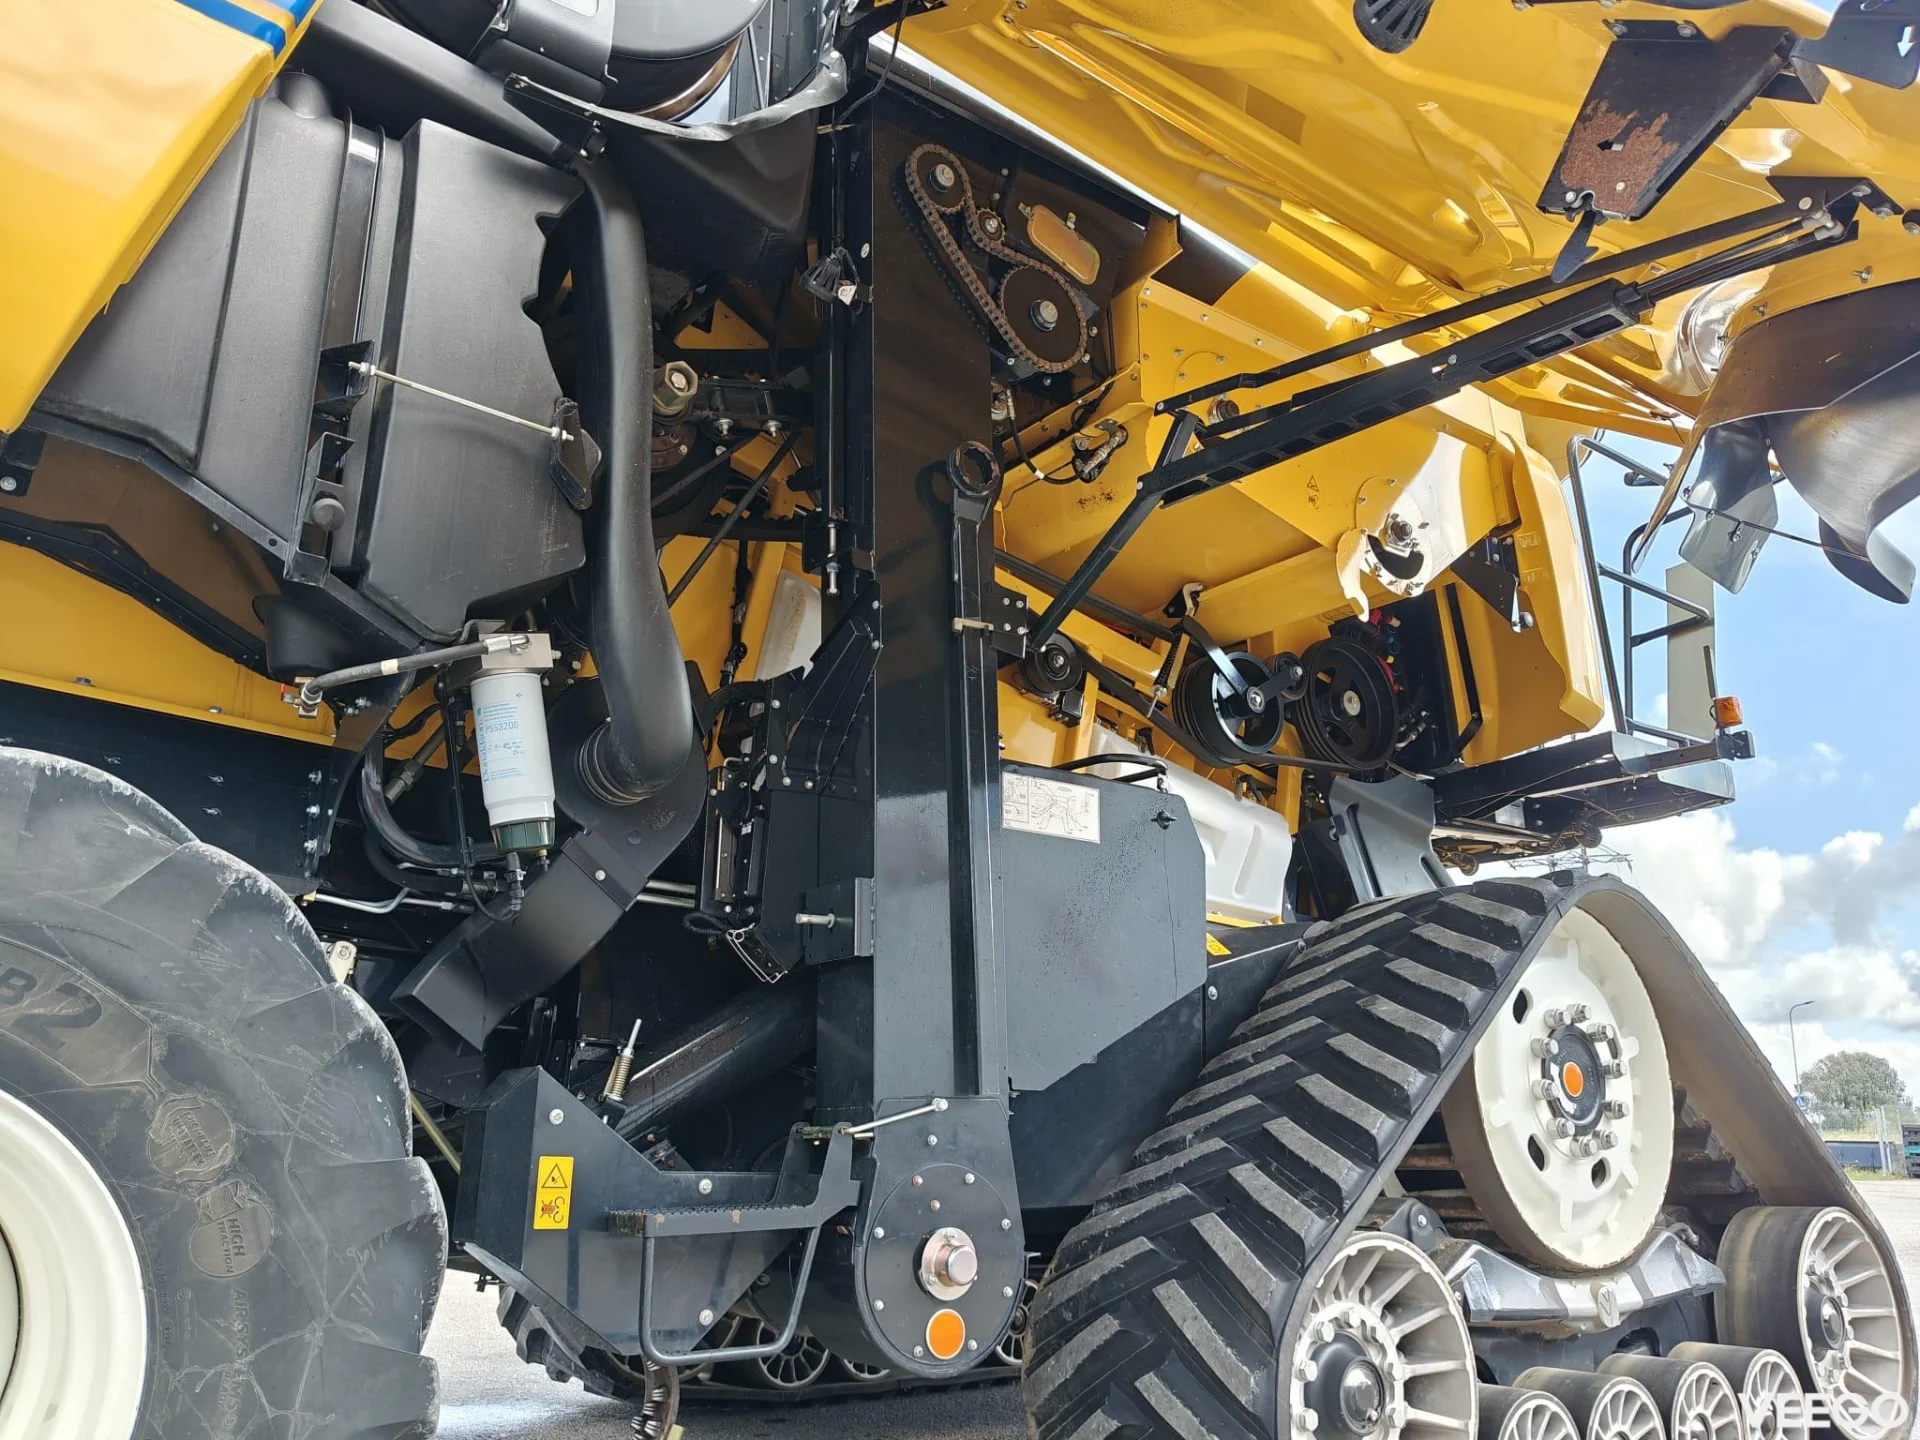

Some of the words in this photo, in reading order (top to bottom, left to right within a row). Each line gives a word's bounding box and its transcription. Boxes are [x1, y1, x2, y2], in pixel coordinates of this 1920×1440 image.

[486, 721, 519, 733] P553200
[217, 1221, 234, 1273] TRACTION
[227, 1218, 247, 1257] HIGH
